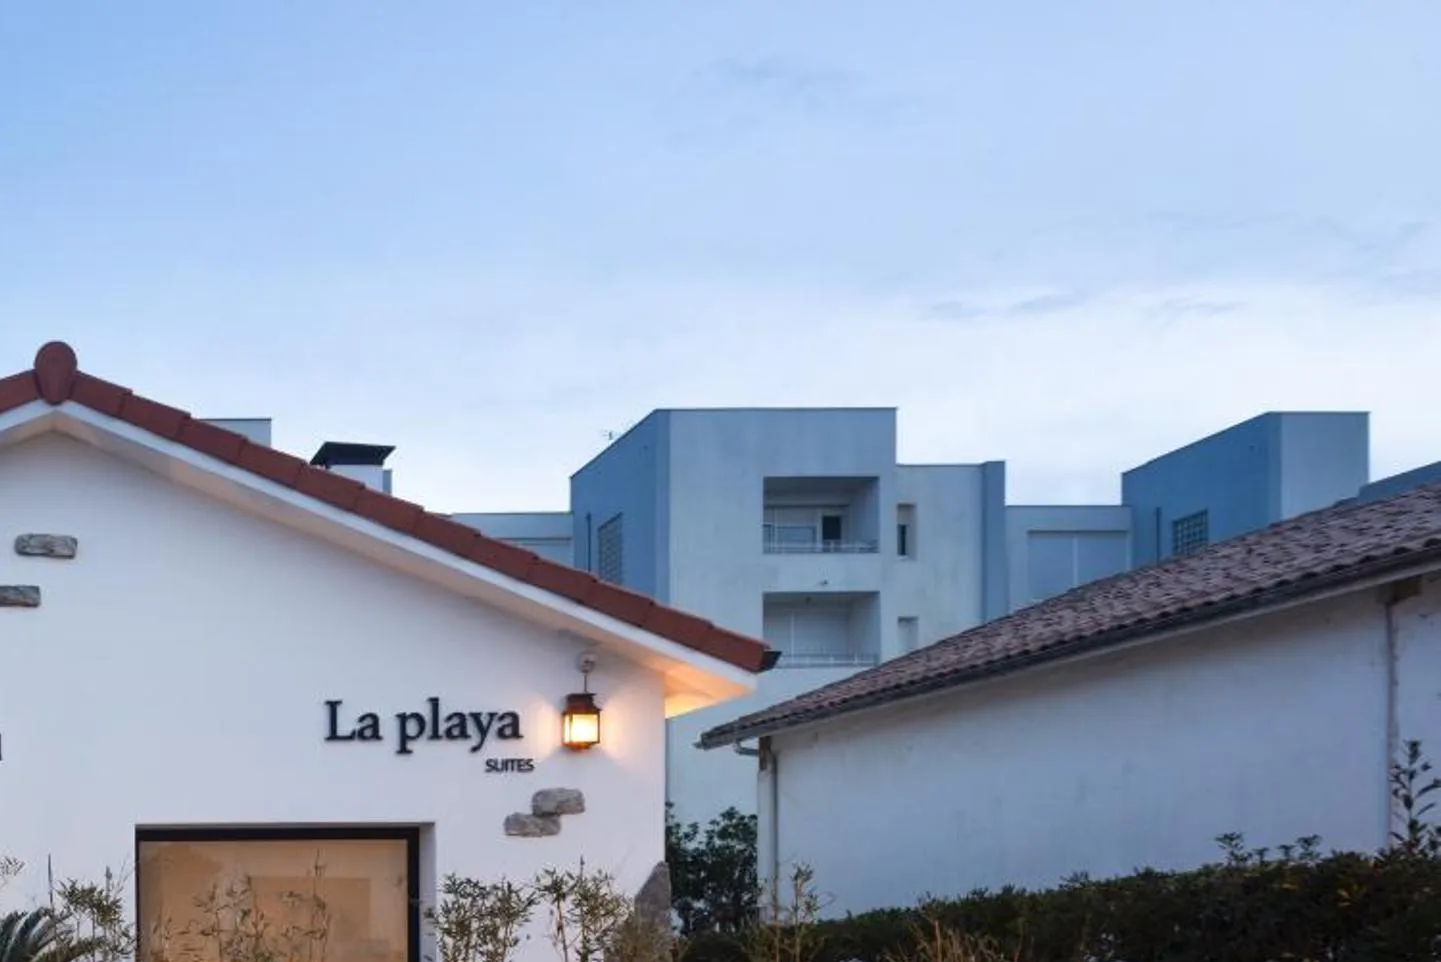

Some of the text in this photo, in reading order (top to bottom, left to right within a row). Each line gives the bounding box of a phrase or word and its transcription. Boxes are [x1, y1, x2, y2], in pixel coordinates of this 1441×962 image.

[325, 697, 523, 754] La playa
[485, 758, 534, 773] SUITES
